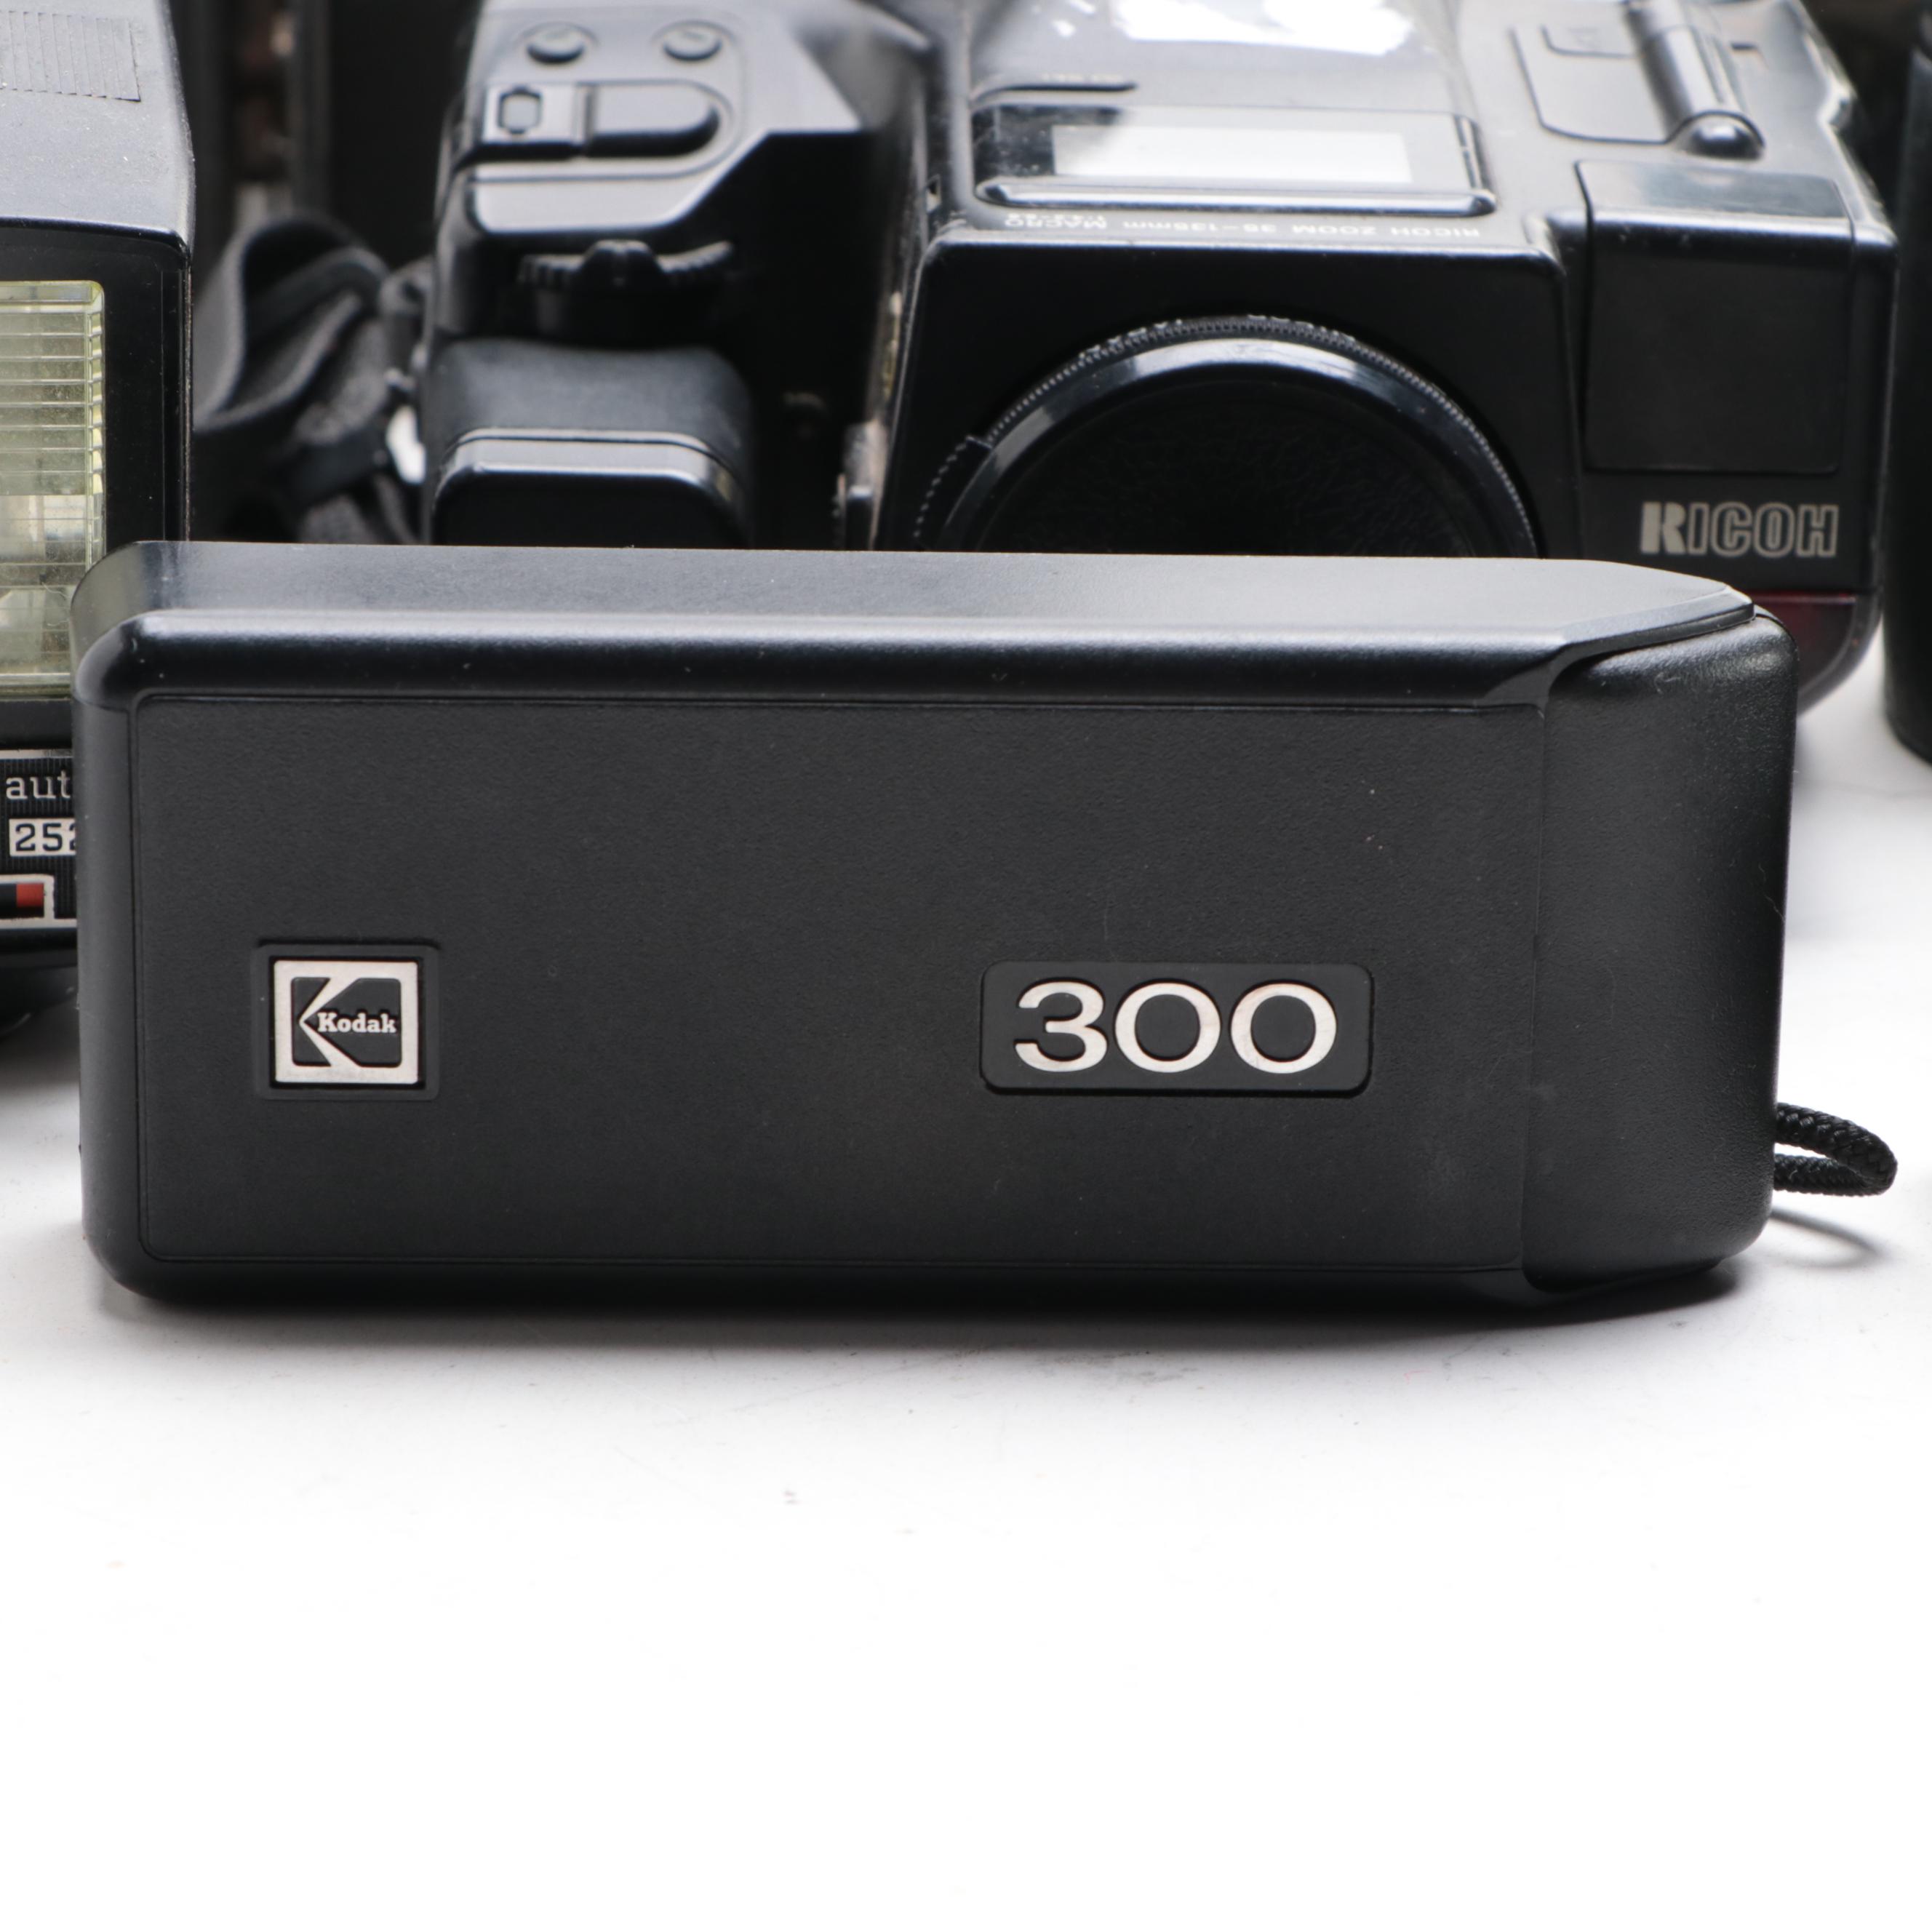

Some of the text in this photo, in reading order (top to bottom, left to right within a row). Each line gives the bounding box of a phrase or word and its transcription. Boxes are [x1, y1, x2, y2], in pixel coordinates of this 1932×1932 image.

[1640, 501, 1839, 558] RICOH
[317, 1011, 397, 1034] Kodak
[1015, 981, 1337, 1074] 300
